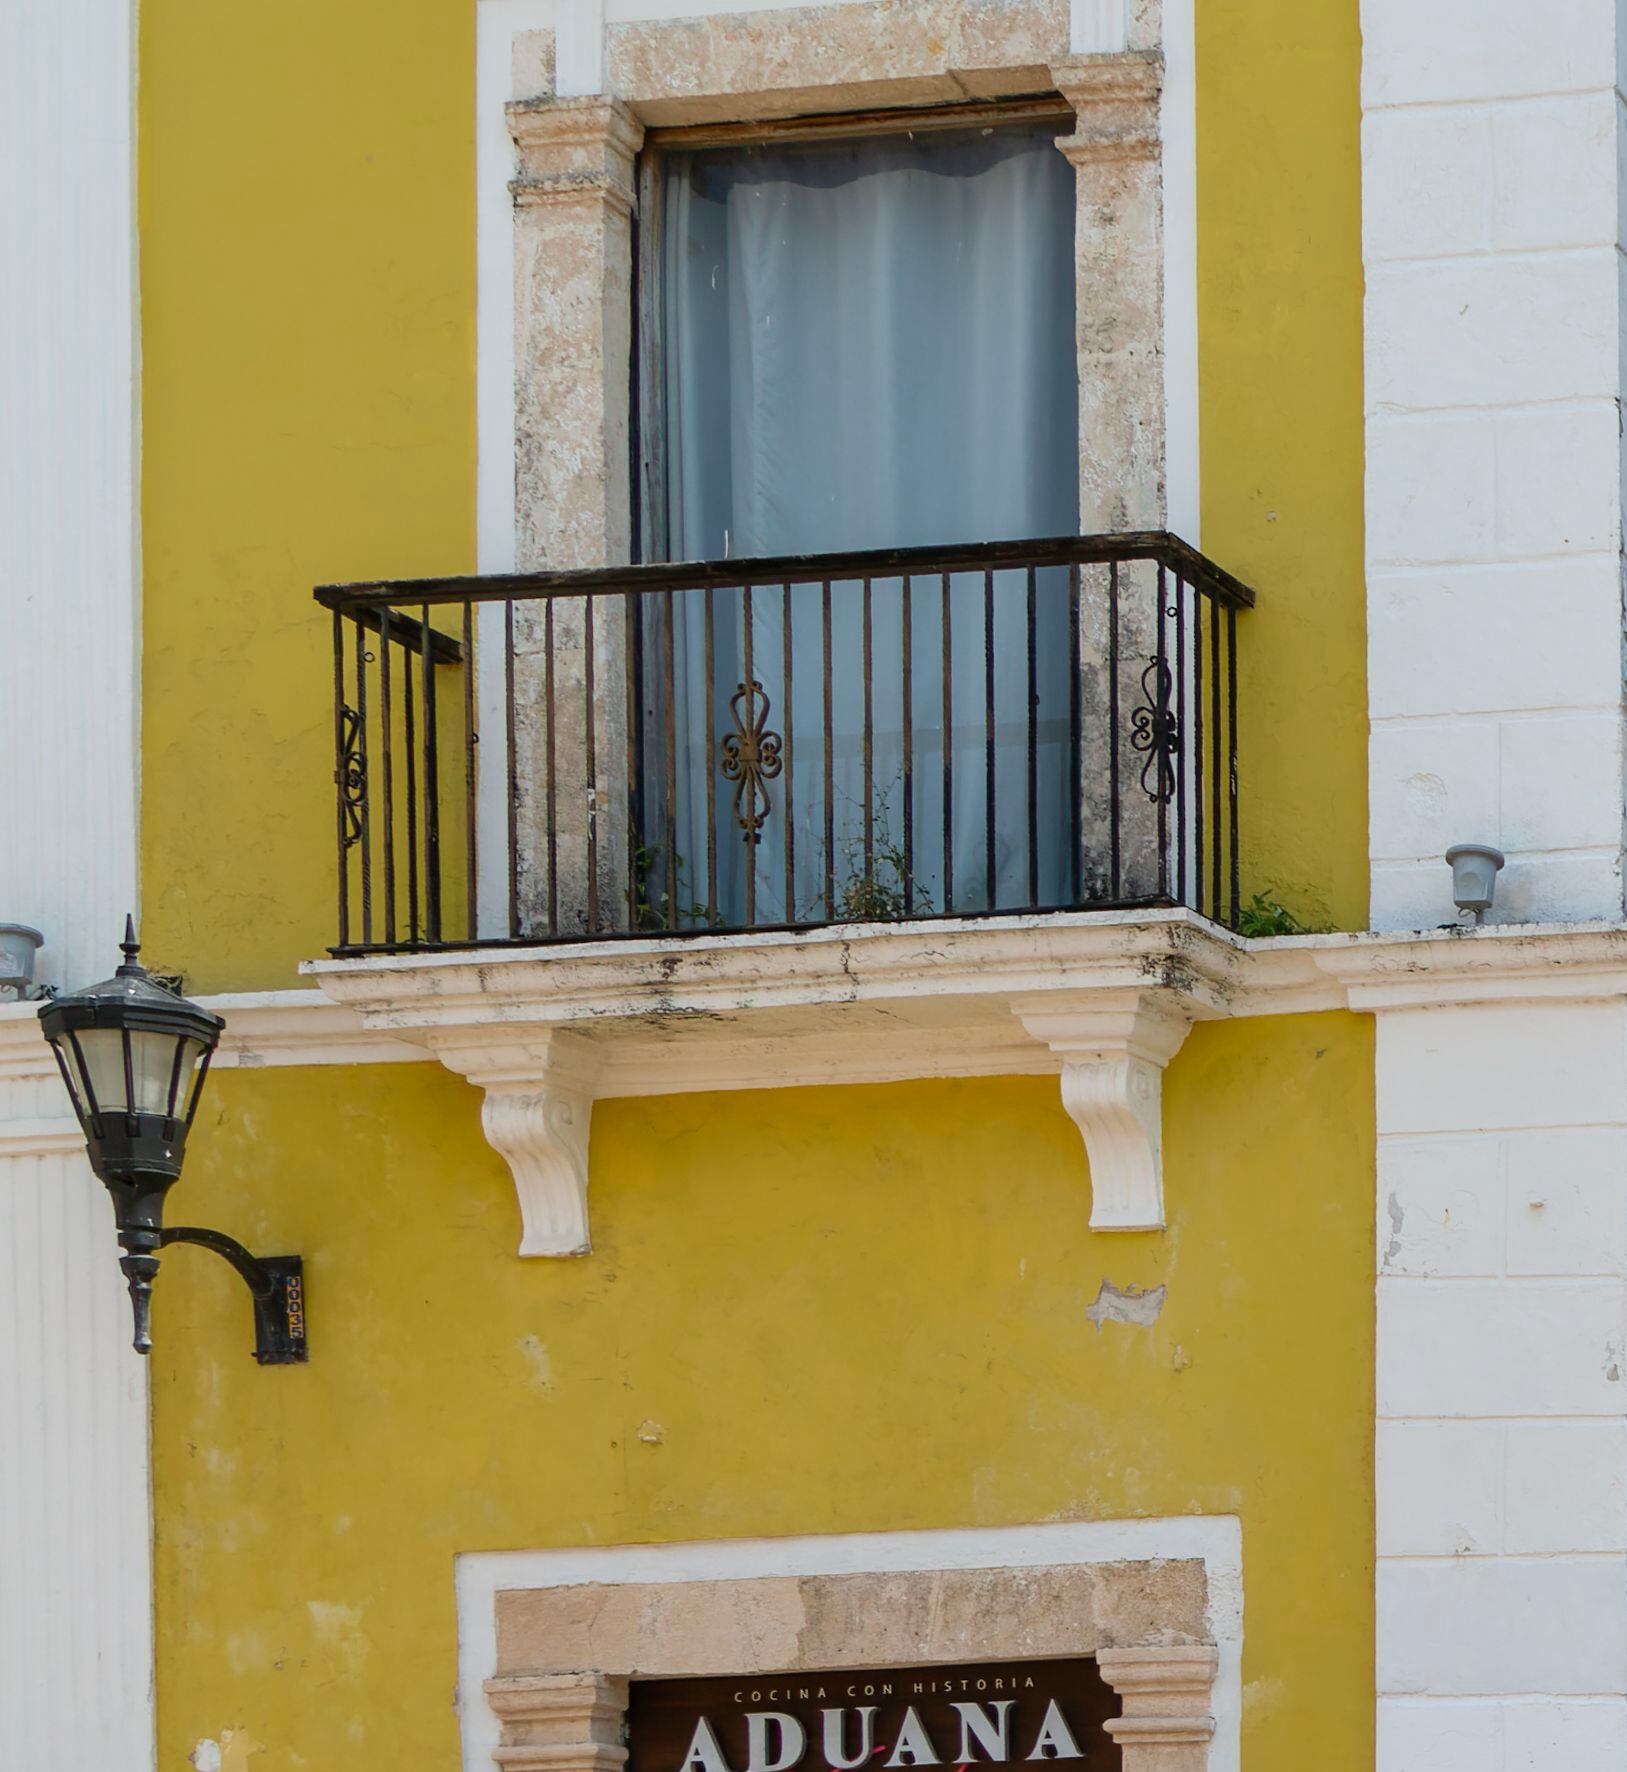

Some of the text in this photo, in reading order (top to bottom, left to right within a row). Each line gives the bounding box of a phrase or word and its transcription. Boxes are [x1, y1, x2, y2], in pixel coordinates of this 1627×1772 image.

[734, 1676, 1035, 1703] COCINA CON HISTORIA
